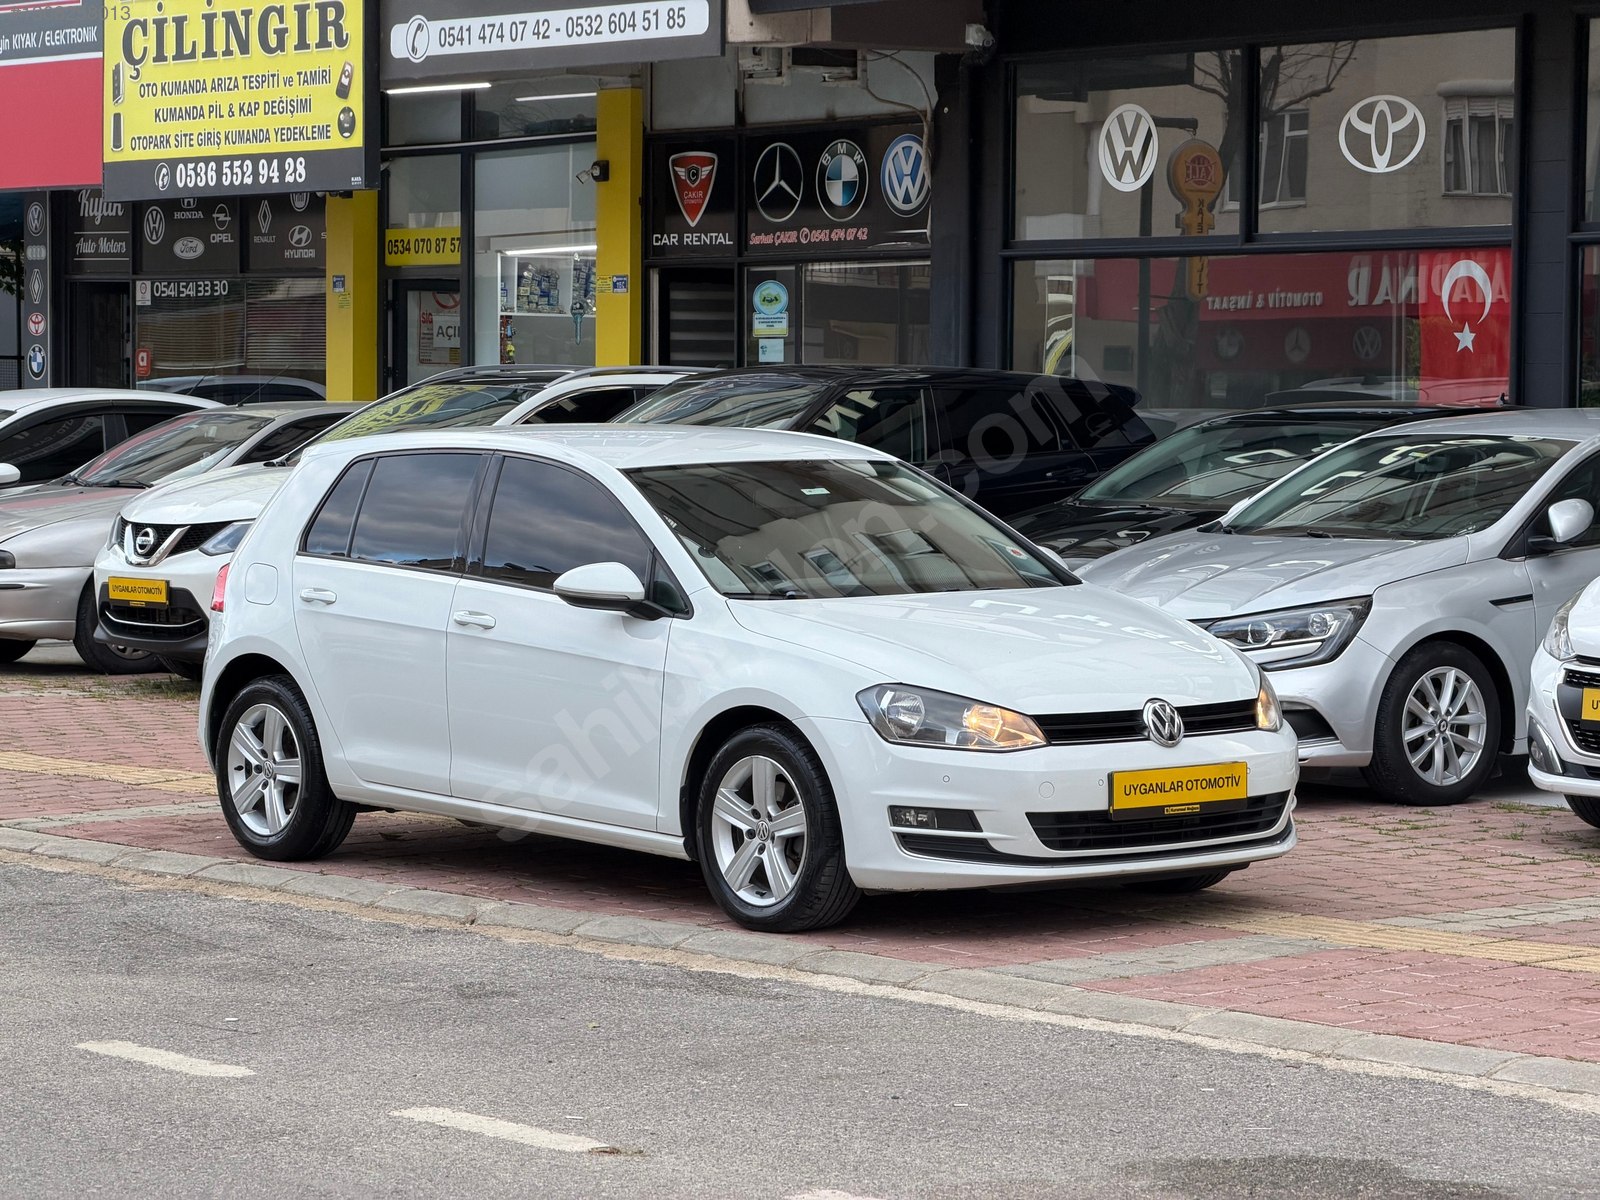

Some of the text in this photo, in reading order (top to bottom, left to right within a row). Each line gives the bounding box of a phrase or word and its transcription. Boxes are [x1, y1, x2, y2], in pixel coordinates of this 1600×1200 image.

[439, 27, 473, 48] 0541
[478, 23, 505, 44] 474
[509, 21, 528, 43] 07
[532, 18, 551, 40] 42
[565, 16, 603, 38] 0532
[608, 11, 637, 35] 604
[642, 9, 660, 31] 51
[667, 6, 686, 29] 85
[12, 31, 37, 49] KIYAK
[138, 67, 332, 98] OTO KUMANDA ARIZA TESPİTİ ve TAMİRİ
[154, 94, 313, 123] KUMANDA PİL & KAP DEĞİŞİMİ
[130, 123, 332, 152] OTOPARK SİTE GİRİŞ KUMANDA YEDEKLEME
[176, 156, 306, 188] 0536 552 94 28
[174, 210, 204, 219] HONDA
[75, 236, 127, 256] Auto Motors
[180, 240, 198, 253] Ford
[210, 233, 234, 243] OPEL
[253, 235, 276, 243] RENAULT
[387, 236, 461, 256] 0534 070 87 57
[652, 232, 734, 246] CAR RENTAL
[284, 249, 316, 258] HYUNDAI
[154, 280, 229, 298] 0541 541 33 30
[112, 584, 163, 596] UYGANLAR OTOMOTİV
[1124, 773, 1241, 796] UYGANLAR OTOMOTİV
